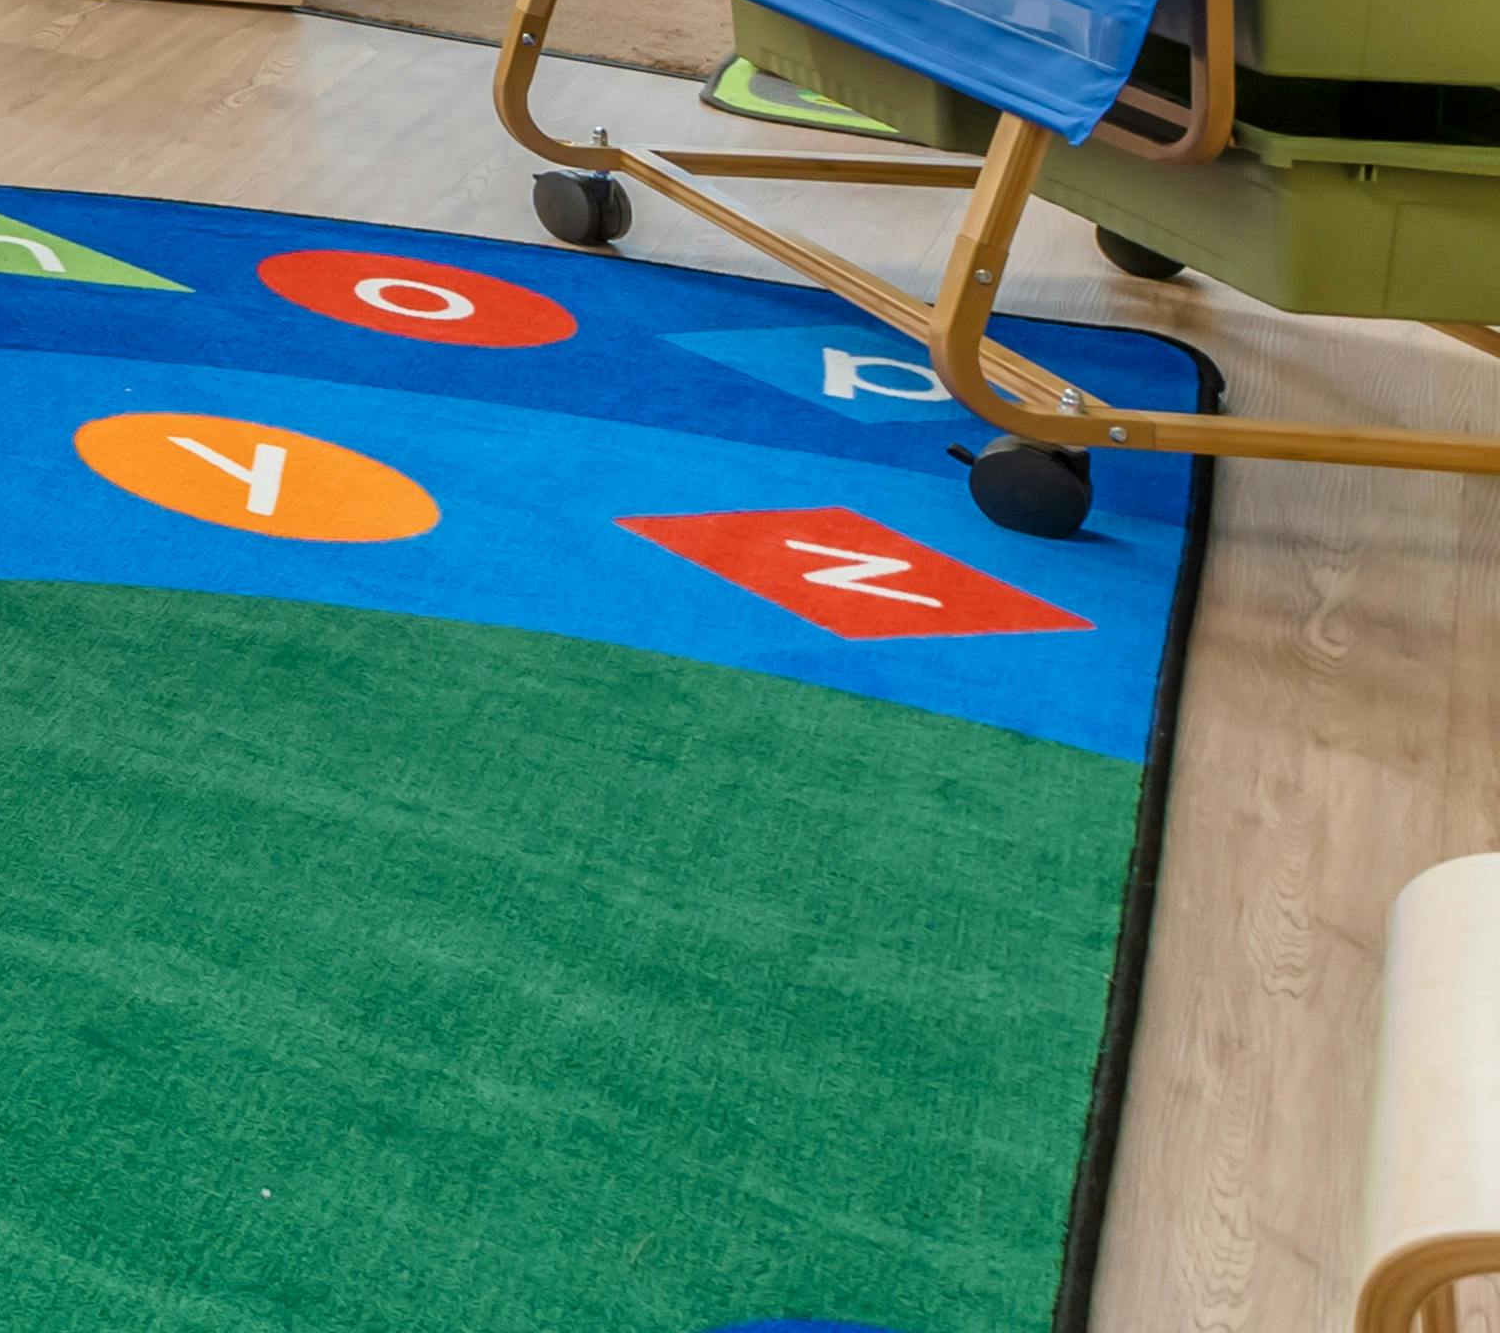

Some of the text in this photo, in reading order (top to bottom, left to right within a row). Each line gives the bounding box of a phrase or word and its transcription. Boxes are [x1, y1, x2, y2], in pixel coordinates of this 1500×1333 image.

[353, 277, 476, 321] o
[823, 347, 953, 402] p
[167, 435, 288, 517] y
[784, 538, 943, 608] z
